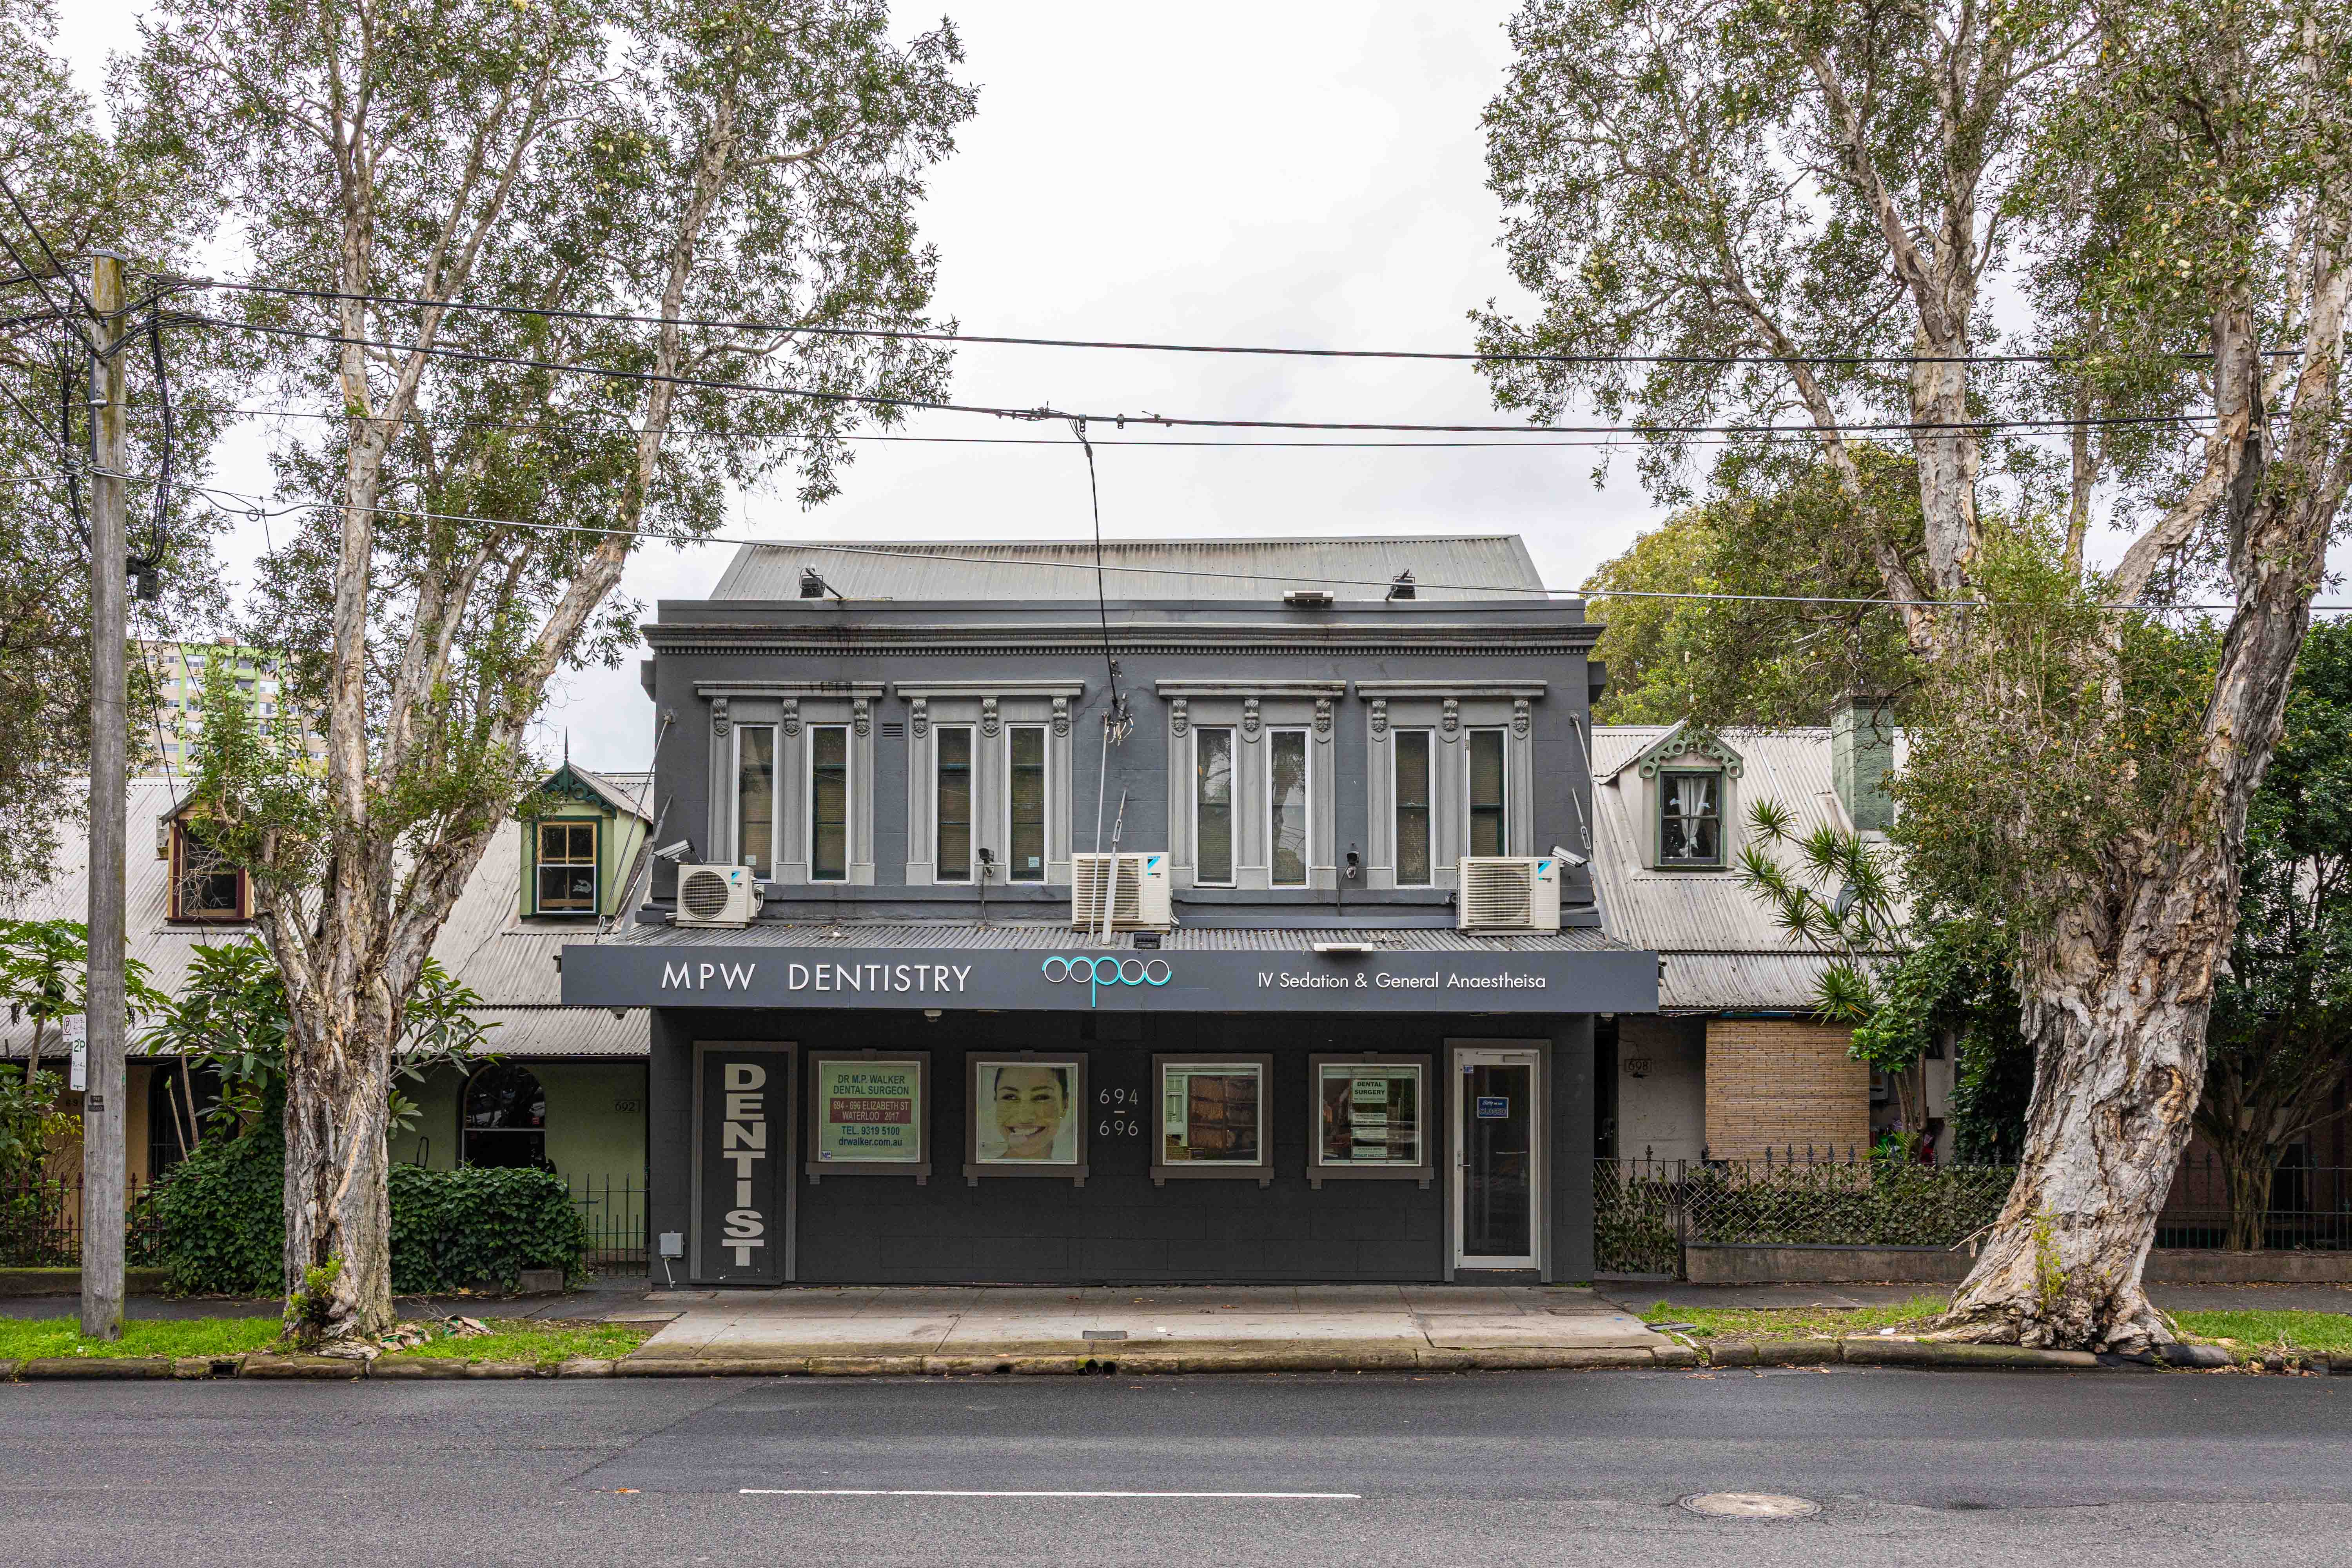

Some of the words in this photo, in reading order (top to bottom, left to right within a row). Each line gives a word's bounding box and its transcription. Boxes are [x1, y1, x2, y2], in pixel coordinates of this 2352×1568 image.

[662, 962, 756, 990] MPW
[789, 964, 972, 992] DENTISTRY
[1258, 972, 1274, 987] IV
[1279, 971, 1348, 988] Sedation
[1355, 973, 1368, 988] &
[1376, 972, 1439, 988] General
[1446, 972, 1546, 988] Anaestheisa
[74, 1040, 85, 1053] 2P
[1628, 1061, 1648, 1071] 698
[838, 1074, 849, 1083] DR
[852, 1075, 867, 1083] M.P.
[870, 1075, 905, 1084] WALKER
[833, 1085, 866, 1094] DENTAL
[868, 1086, 909, 1095] SURGEON
[1100, 1089, 1138, 1105] 694
[615, 1101, 635, 1112] 692
[833, 1101, 844, 1110] 694
[849, 1101, 860, 1110] 696
[862, 1101, 898, 1110] ELIZABETH
[900, 1102, 909, 1111] ST
[843, 1111, 879, 1120] WATERLOO
[885, 1112, 899, 1121] 2017
[841, 1126, 859, 1135] TEL.
[861, 1126, 879, 1135] 9319
[882, 1127, 900, 1135] 5100
[1100, 1120, 1138, 1136] 696
[838, 1137, 902, 1146] drwalker.com.au
[722, 1063, 767, 1267] DENTIST
